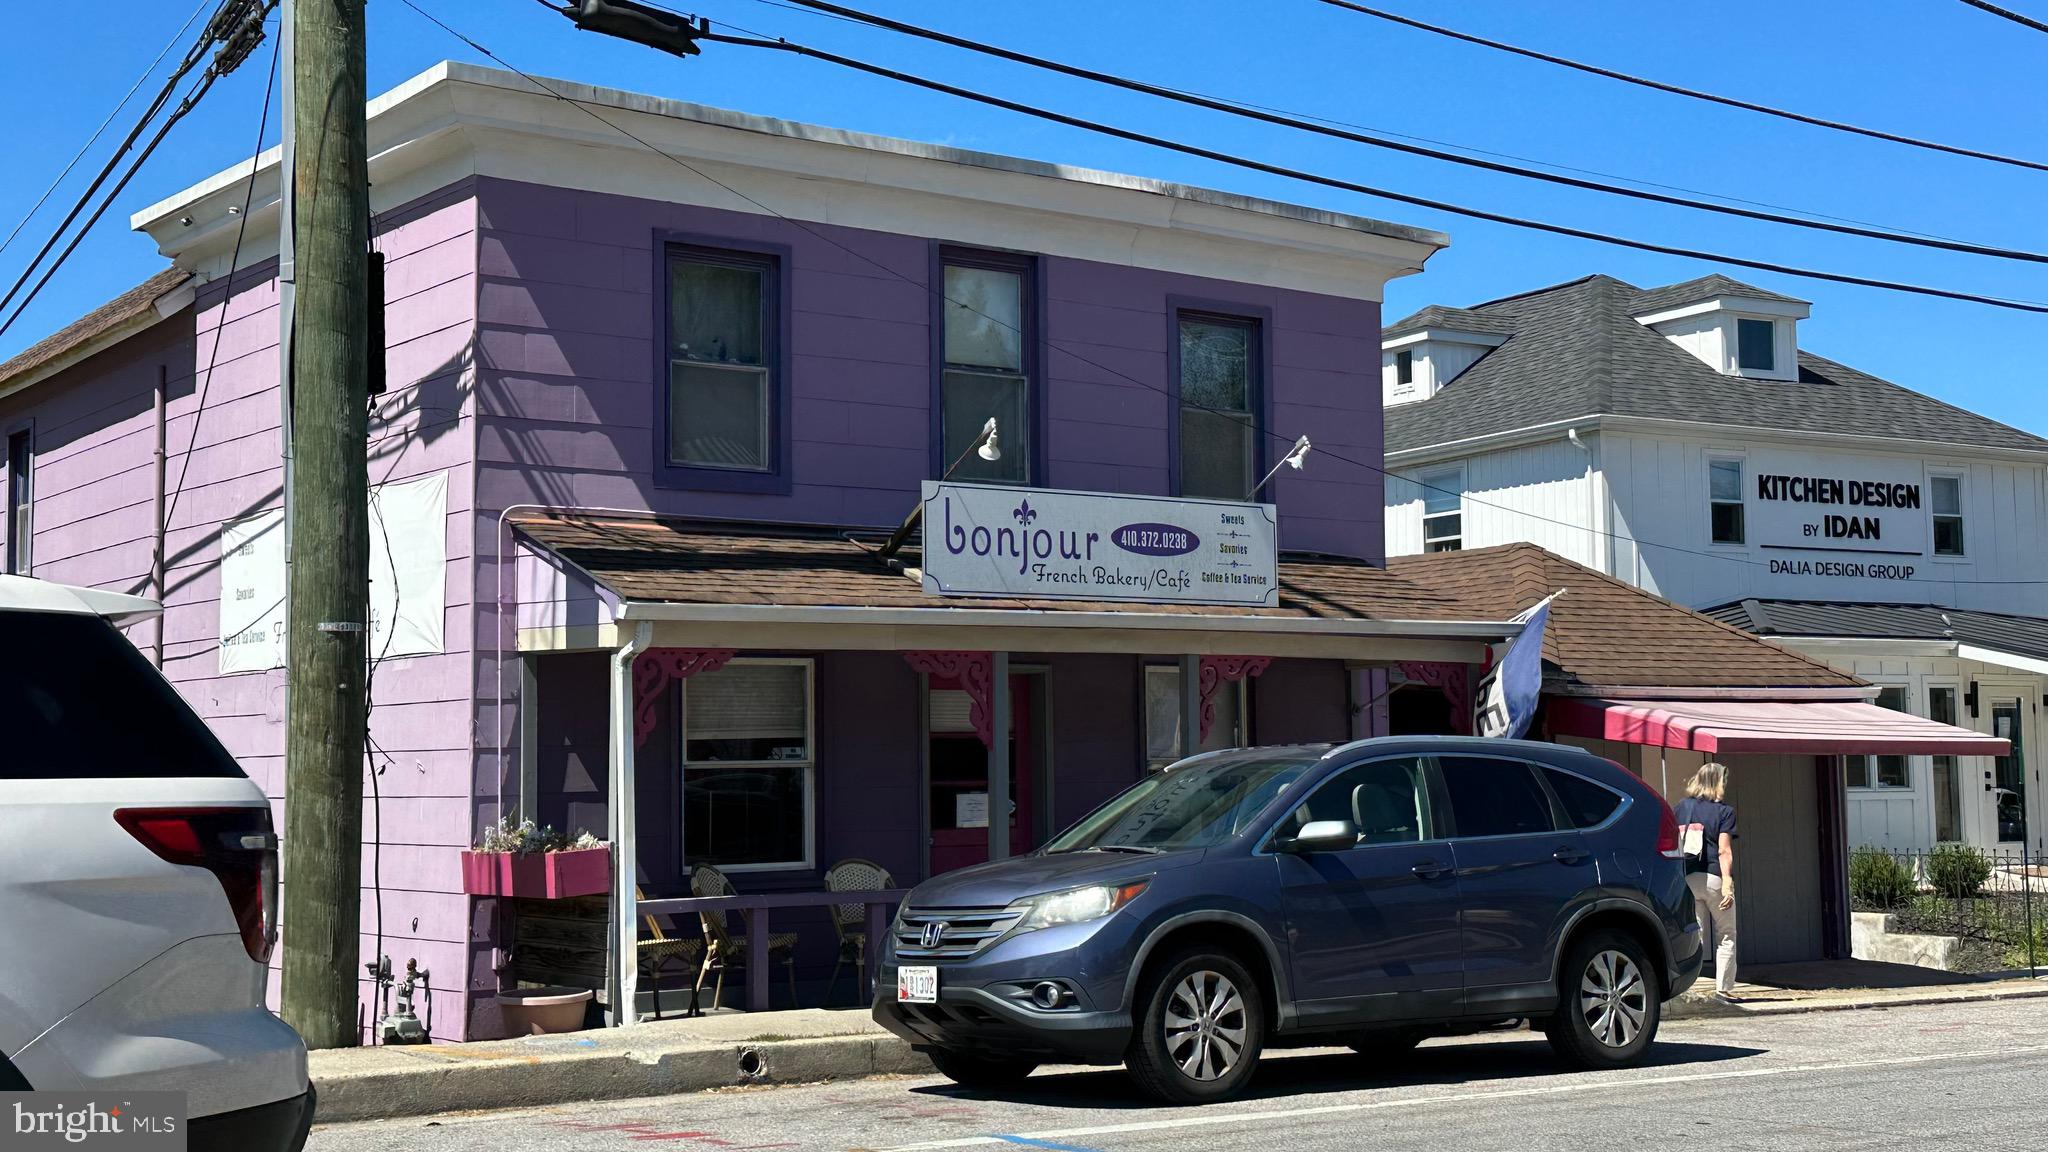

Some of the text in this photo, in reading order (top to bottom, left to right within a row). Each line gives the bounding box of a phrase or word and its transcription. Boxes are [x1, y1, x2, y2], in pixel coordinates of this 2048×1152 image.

[1758, 474, 1920, 509] KITCHEN DESIGN
[1221, 513, 1245, 525] Sweets
[1803, 515, 1880, 540] BY IDAN
[945, 497, 1099, 575] bonjour
[1121, 530, 1187, 550] 410.372.0238
[1220, 543, 1248, 555] Savories
[1032, 564, 1191, 592] French Bakery/Café
[1202, 572, 1223, 583] Coffee
[1231, 573, 1242, 584] Tea
[1243, 574, 1267, 585] Service
[1770, 560, 1914, 580] DALIA DESIGN GROUP
